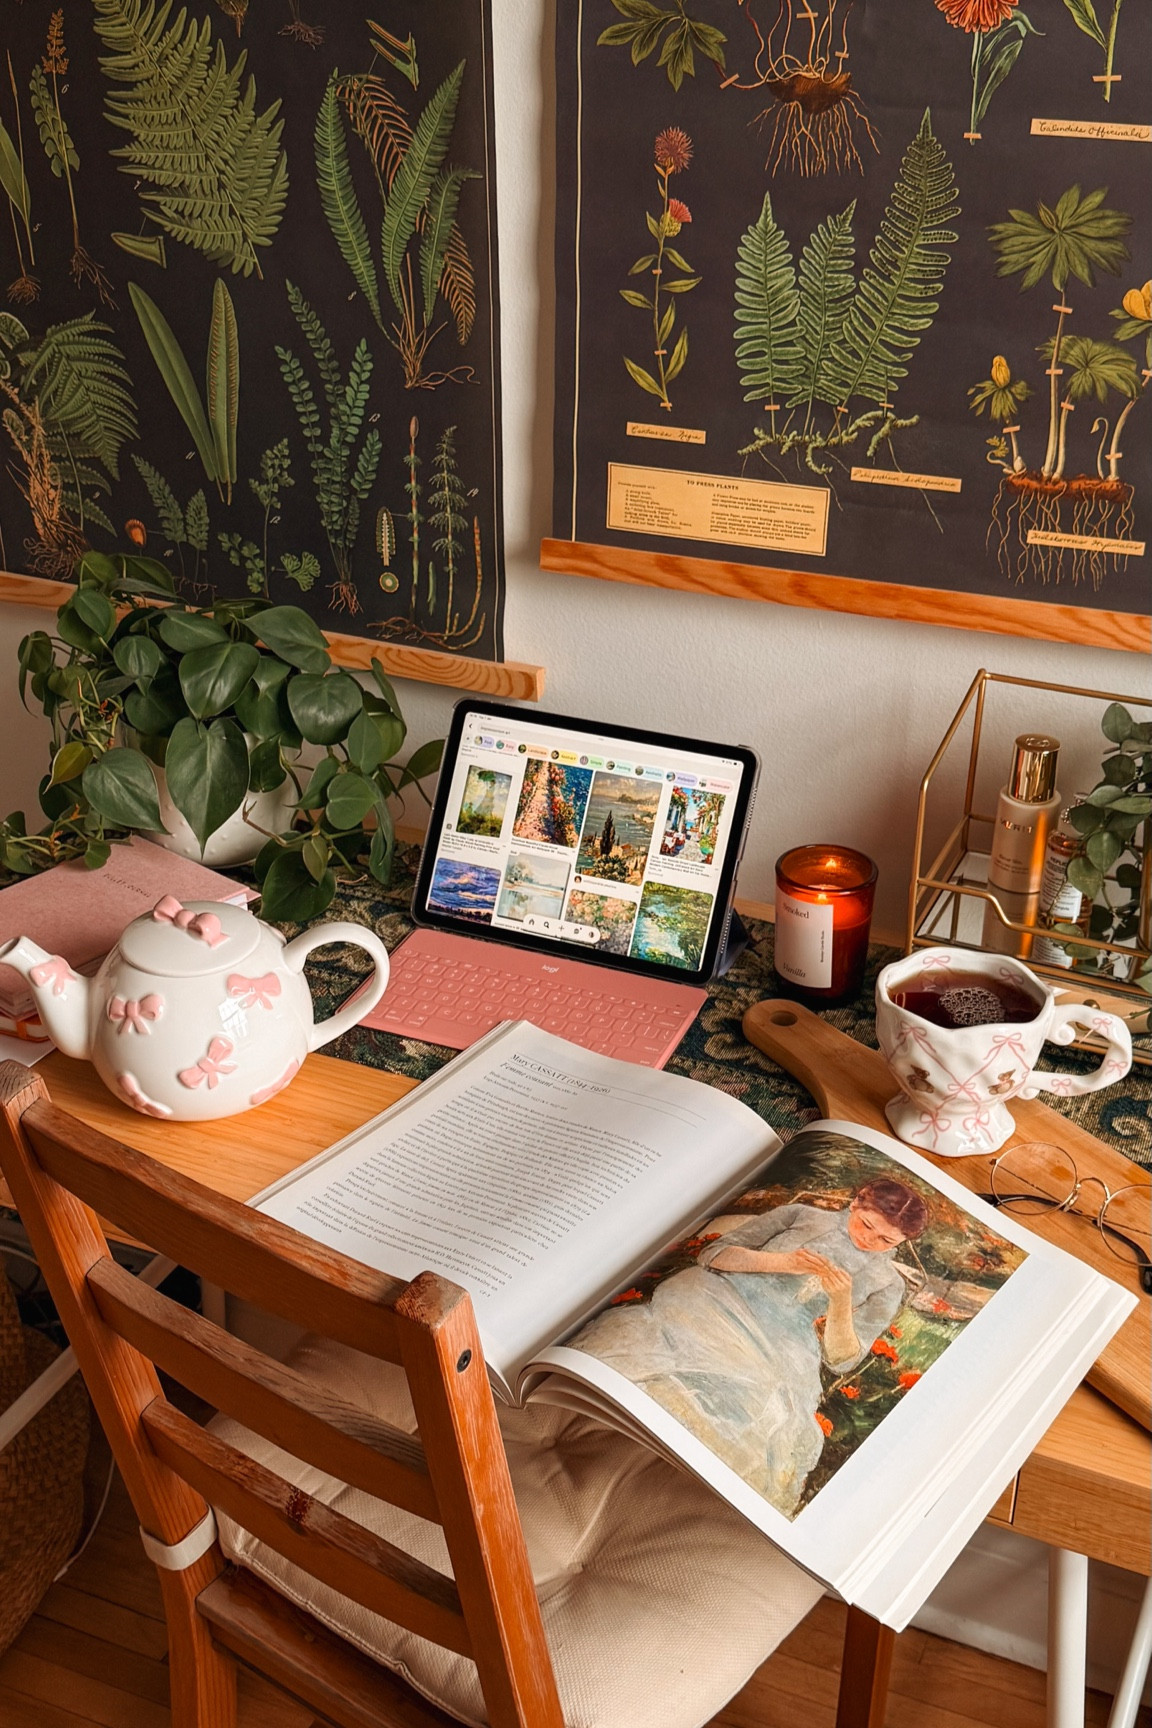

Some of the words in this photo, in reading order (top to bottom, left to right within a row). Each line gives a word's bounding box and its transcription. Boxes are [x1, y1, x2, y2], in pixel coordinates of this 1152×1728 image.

[696, 481, 715, 489] PRESS
[716, 483, 739, 491] PLANTS
[782, 902, 810, 919] Smoked
[783, 962, 806, 978] Vanilla
[500, 1062, 527, 1077] Femme
[525, 1074, 553, 1088] cousant
[511, 1053, 529, 1067] Mary
[530, 1063, 568, 1082] CASSATT
